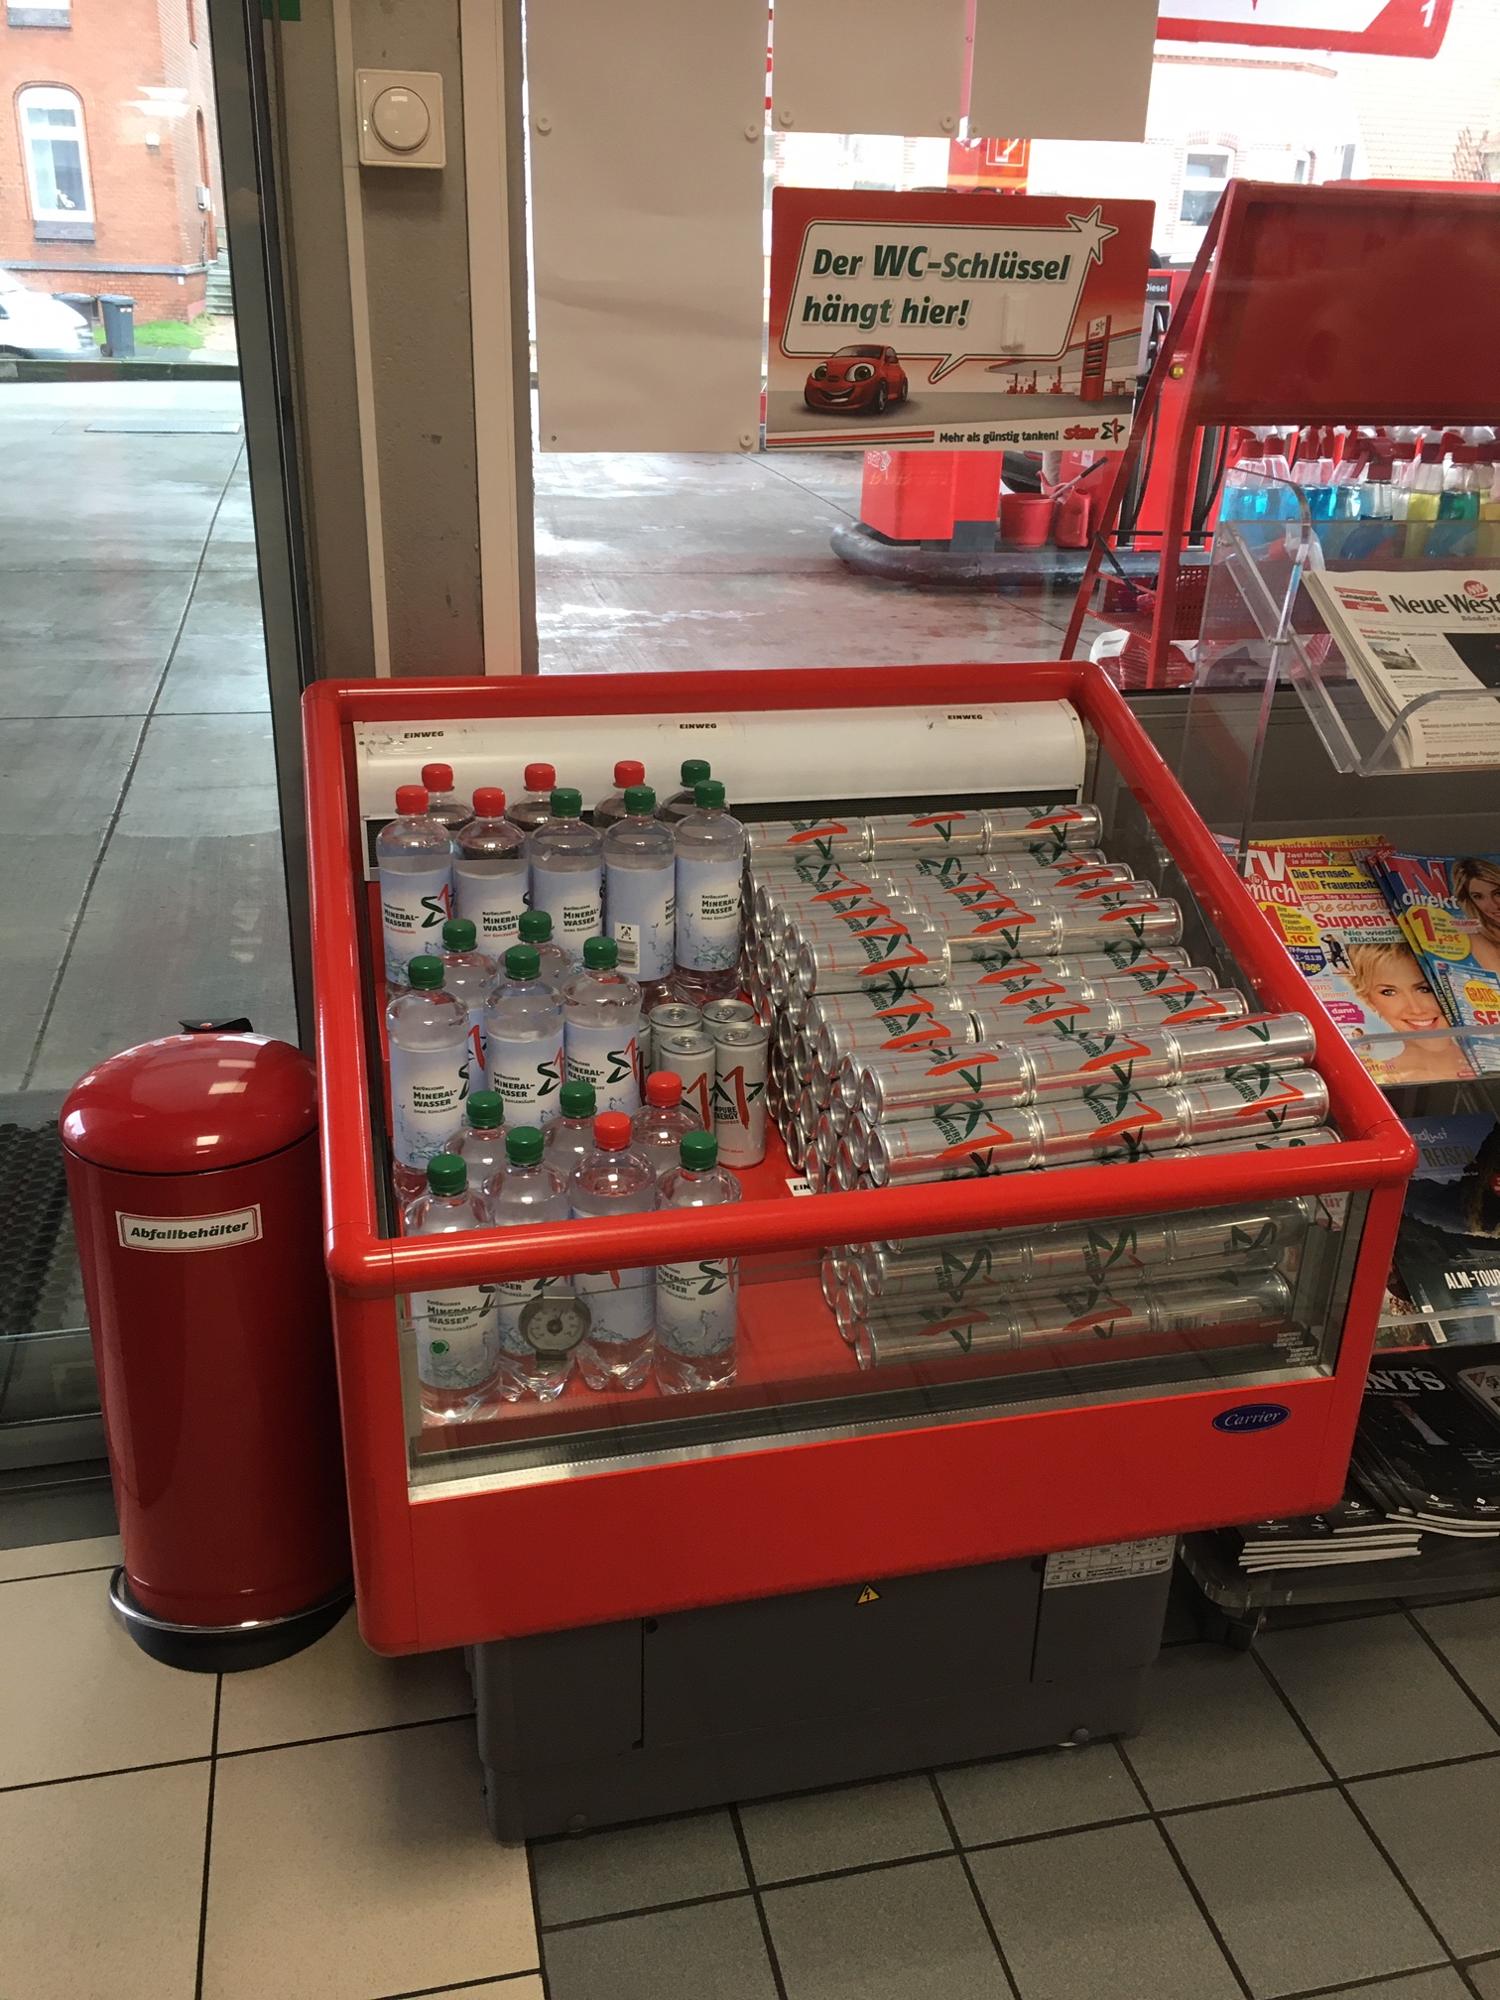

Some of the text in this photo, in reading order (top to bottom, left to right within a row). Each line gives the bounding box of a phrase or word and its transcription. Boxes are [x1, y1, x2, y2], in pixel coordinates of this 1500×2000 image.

[812, 244, 1072, 281] Der WC-Schlüssel
[802, 294, 970, 329] hängt hier!
[940, 430, 1059, 444] Mehr als günstig tanken!
[1063, 427, 1099, 441] star
[1389, 594, 1449, 613] Neue
[1291, 868, 1354, 878] Die Fernseh-
[1246, 878, 1298, 903] mich
[1296, 881, 1319, 890] UND
[702, 898, 737, 907] MINERAL-
[1402, 889, 1460, 909] direkt
[701, 906, 732, 914] WASSER
[1306, 901, 1332, 913] Die
[483, 914, 520, 924] MINERAL
[563, 908, 599, 919] MINERAL-
[483, 922, 517, 932] WASSER
[563, 916, 595, 926] WASSER
[1473, 1010, 1500, 1026] SE
[494, 1077, 536, 1090] MINERAL-
[413, 1089, 457, 1100] MINERAL-
[494, 1086, 528, 1097] WASSER
[413, 1098, 451, 1107] WASSER
[130, 1221, 249, 1241] Abfallbehälter
[1224, 1410, 1282, 1428] Carrier
